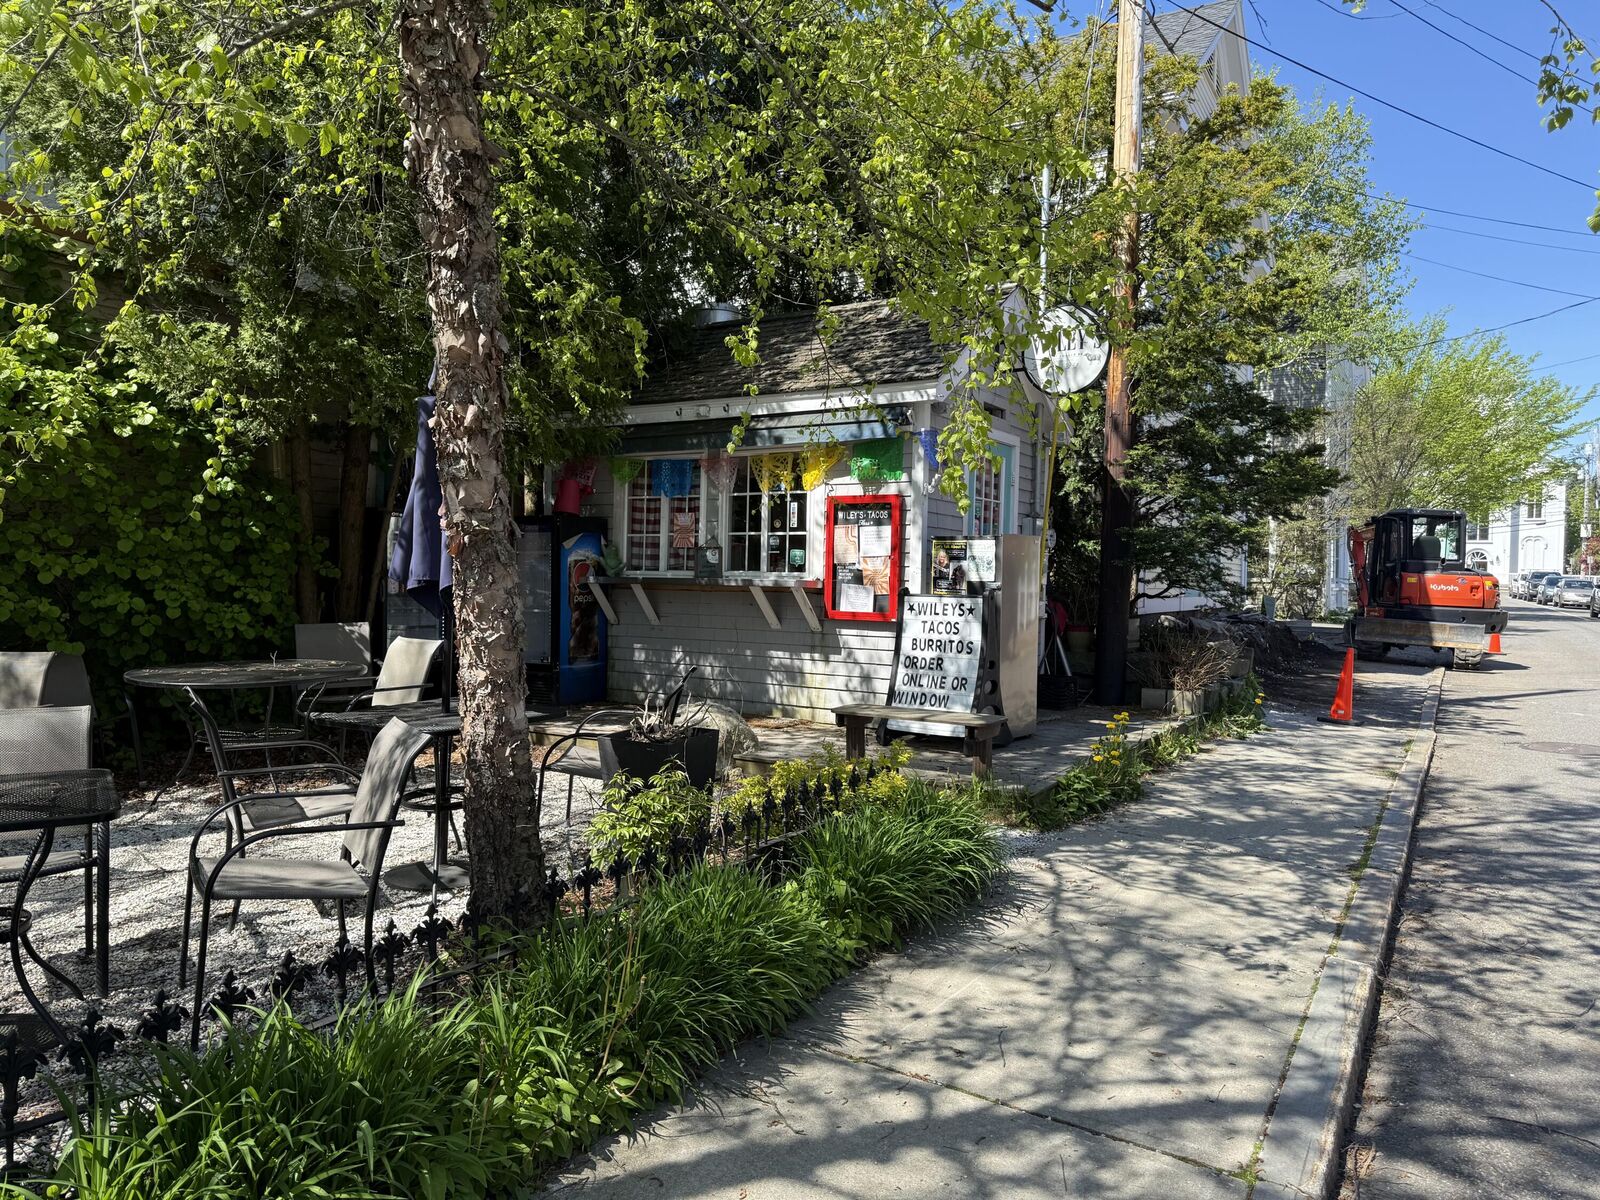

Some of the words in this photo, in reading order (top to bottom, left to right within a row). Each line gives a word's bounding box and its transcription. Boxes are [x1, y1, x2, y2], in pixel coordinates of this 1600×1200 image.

[867, 511, 888, 519] TACOS
[1430, 583, 1459, 592] Kubota
[917, 603, 965, 617] WILEYS
[921, 621, 960, 635] TACOS
[911, 638, 974, 655] BURRITOS
[903, 656, 944, 671] ORDER
[902, 673, 947, 689] ONLINE
[951, 677, 968, 691] OR
[893, 691, 950, 708] WINDOW
